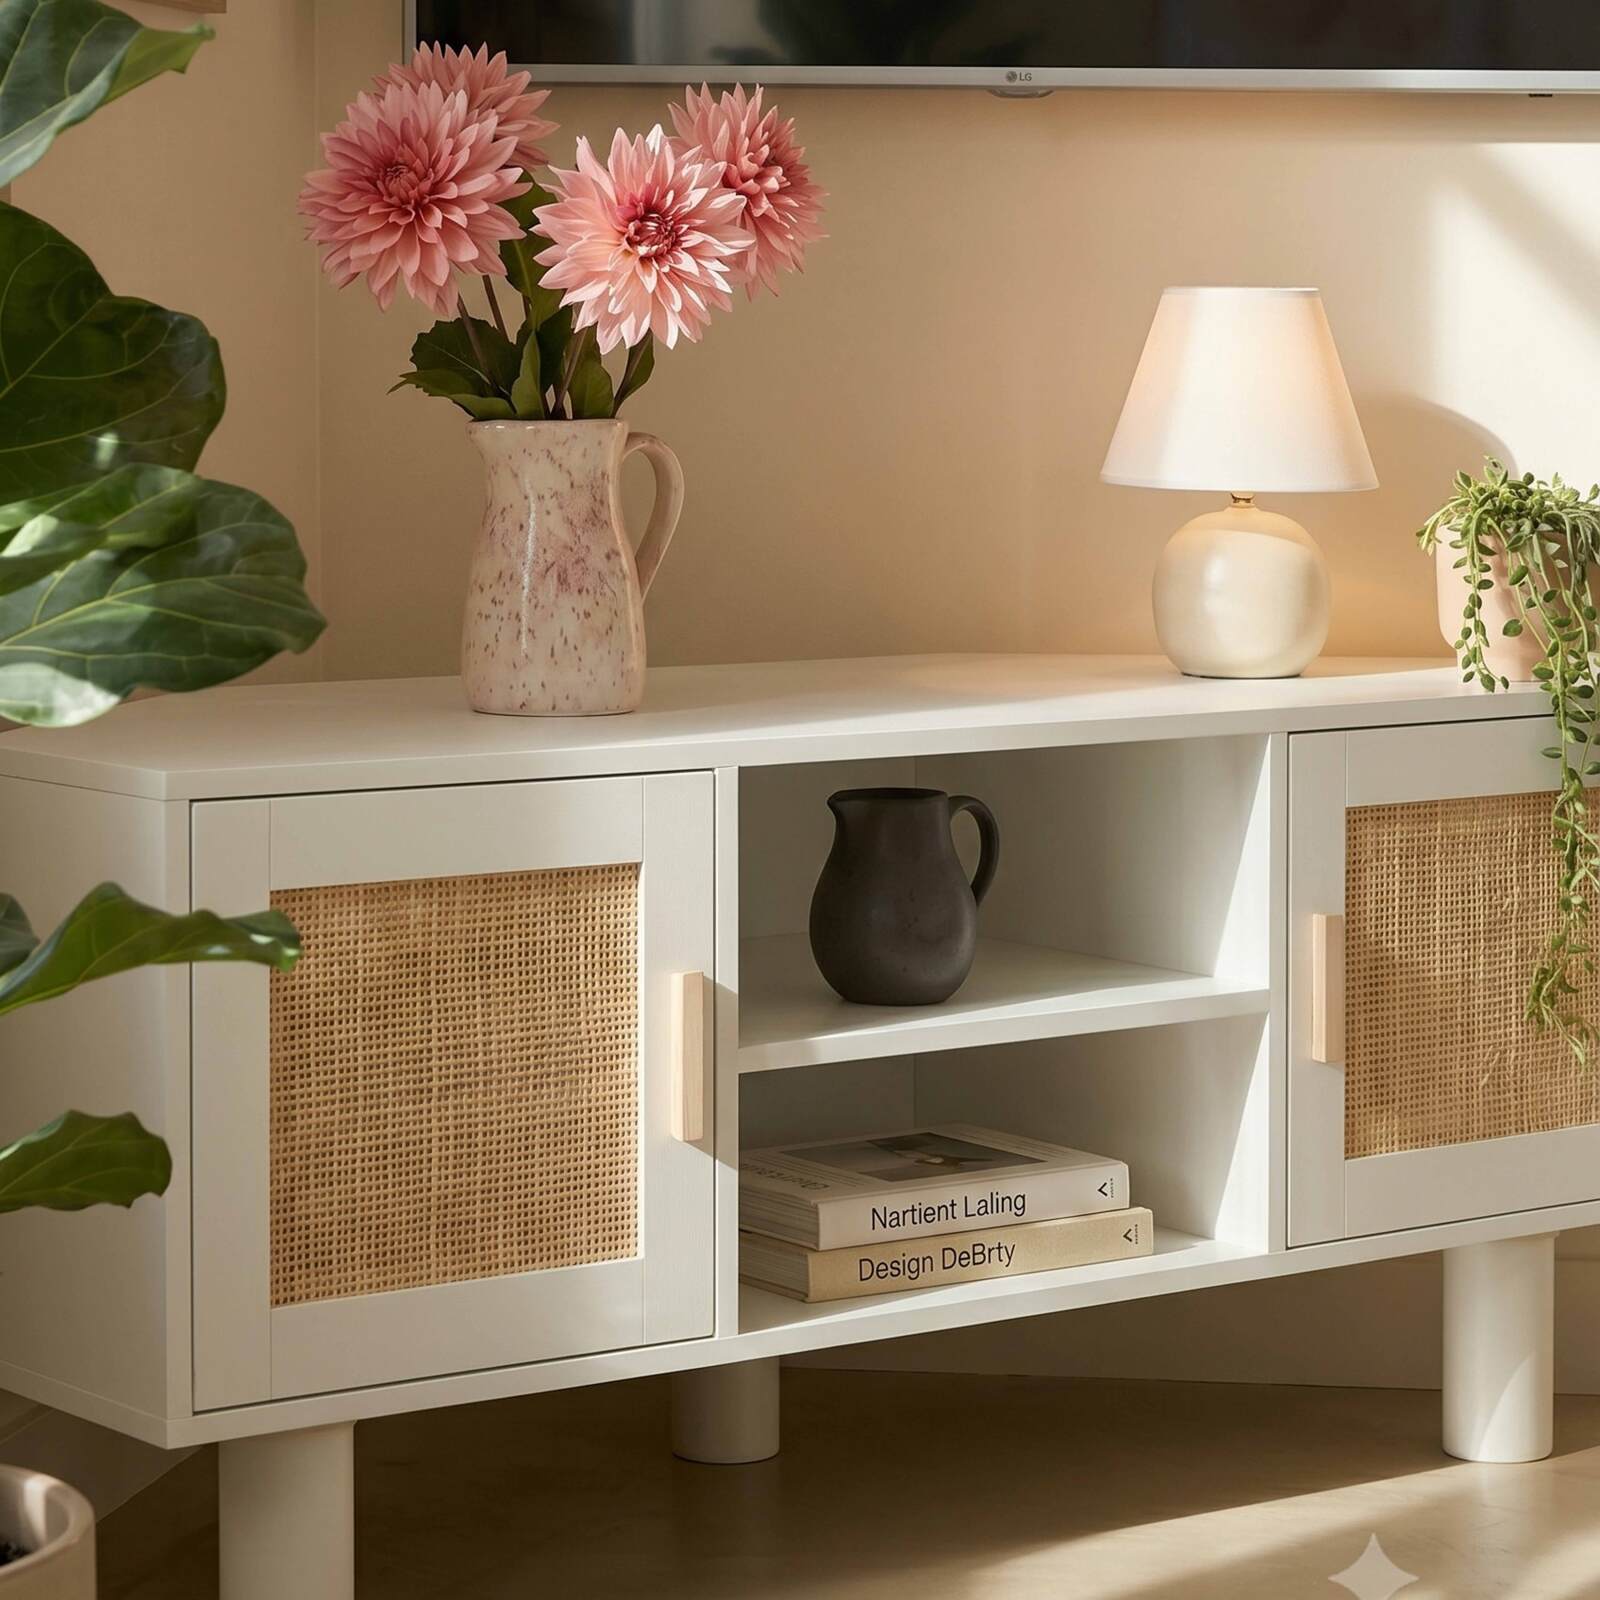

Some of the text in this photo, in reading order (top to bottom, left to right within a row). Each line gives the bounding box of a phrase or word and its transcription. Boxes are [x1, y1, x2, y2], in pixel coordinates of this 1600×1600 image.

[1019, 72, 1033, 82] LG
[871, 1191, 1026, 1231] Nartient Laling
[858, 1241, 1016, 1282] Design DeBrty
